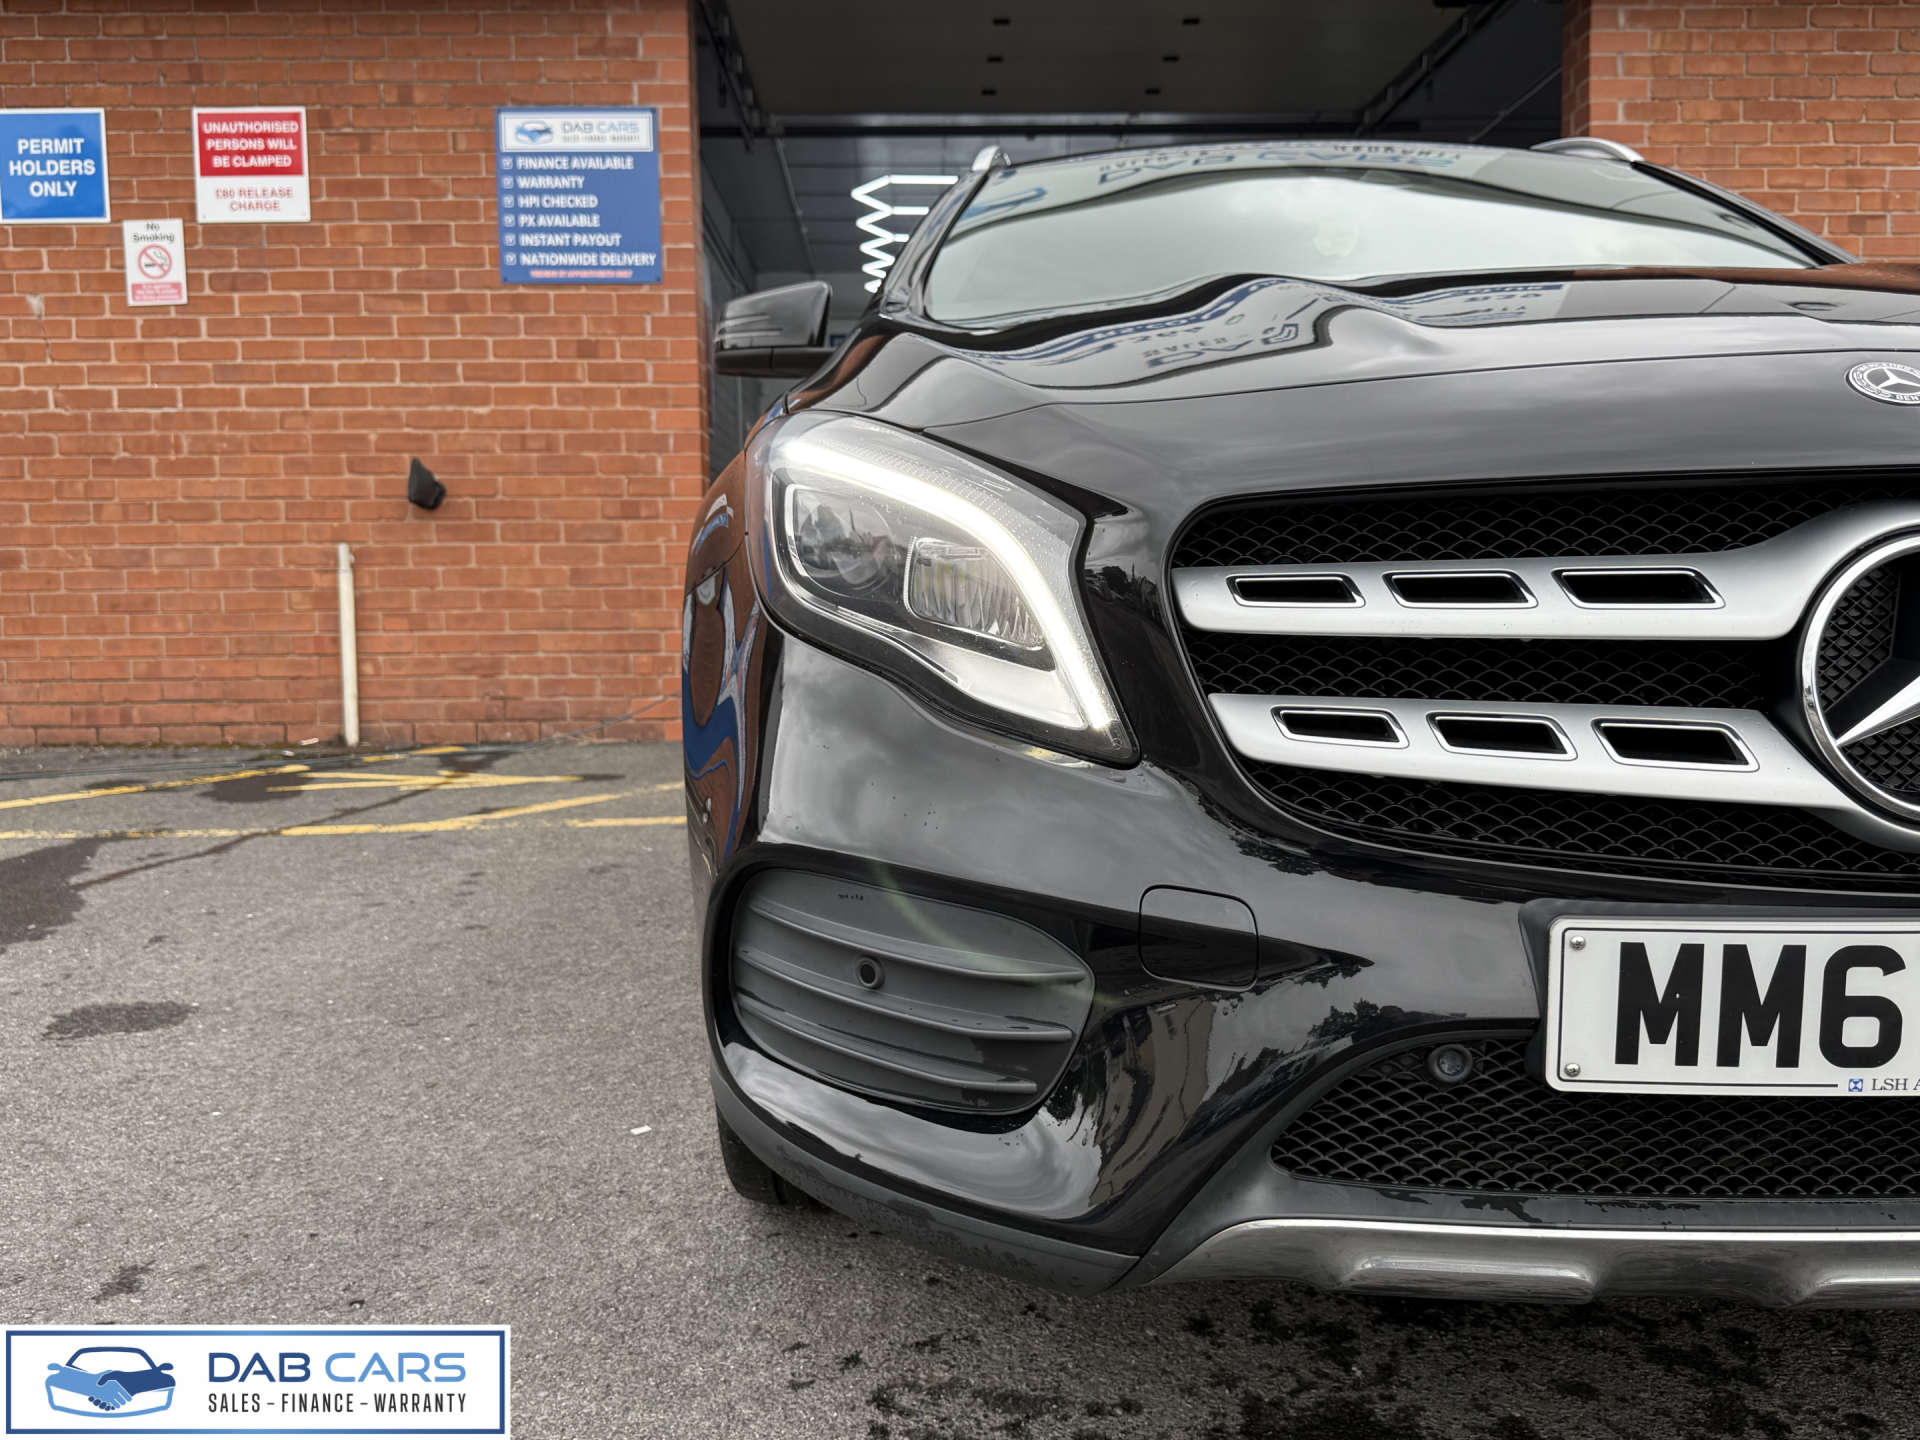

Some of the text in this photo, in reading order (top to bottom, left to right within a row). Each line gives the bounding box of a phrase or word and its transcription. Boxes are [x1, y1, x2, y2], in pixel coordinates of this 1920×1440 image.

[203, 120, 299, 134] UNAUTHORISED
[17, 137, 85, 155] PERMIT
[206, 138, 298, 151] PERSONS WILL
[9, 158, 97, 177] HOLDERS
[212, 154, 292, 168] BE CLAMPED
[517, 156, 635, 170] FINANCE AVAILABLE
[29, 180, 78, 198] ONLY
[517, 175, 585, 189] WARRANTY
[238, 186, 294, 199] RELEASE
[230, 199, 281, 212] CHARGE
[518, 194, 599, 208] HPI CHECKED
[145, 222, 161, 232] No
[519, 214, 601, 228] PX AVAILABLE
[132, 233, 175, 244] Smoking
[520, 233, 622, 247] INSTANT PAYOUT
[520, 252, 657, 266] NATIONWIDE DELIVERY
[1615, 941, 1907, 1069] MM6
[1871, 1078, 1909, 1091] LSH
